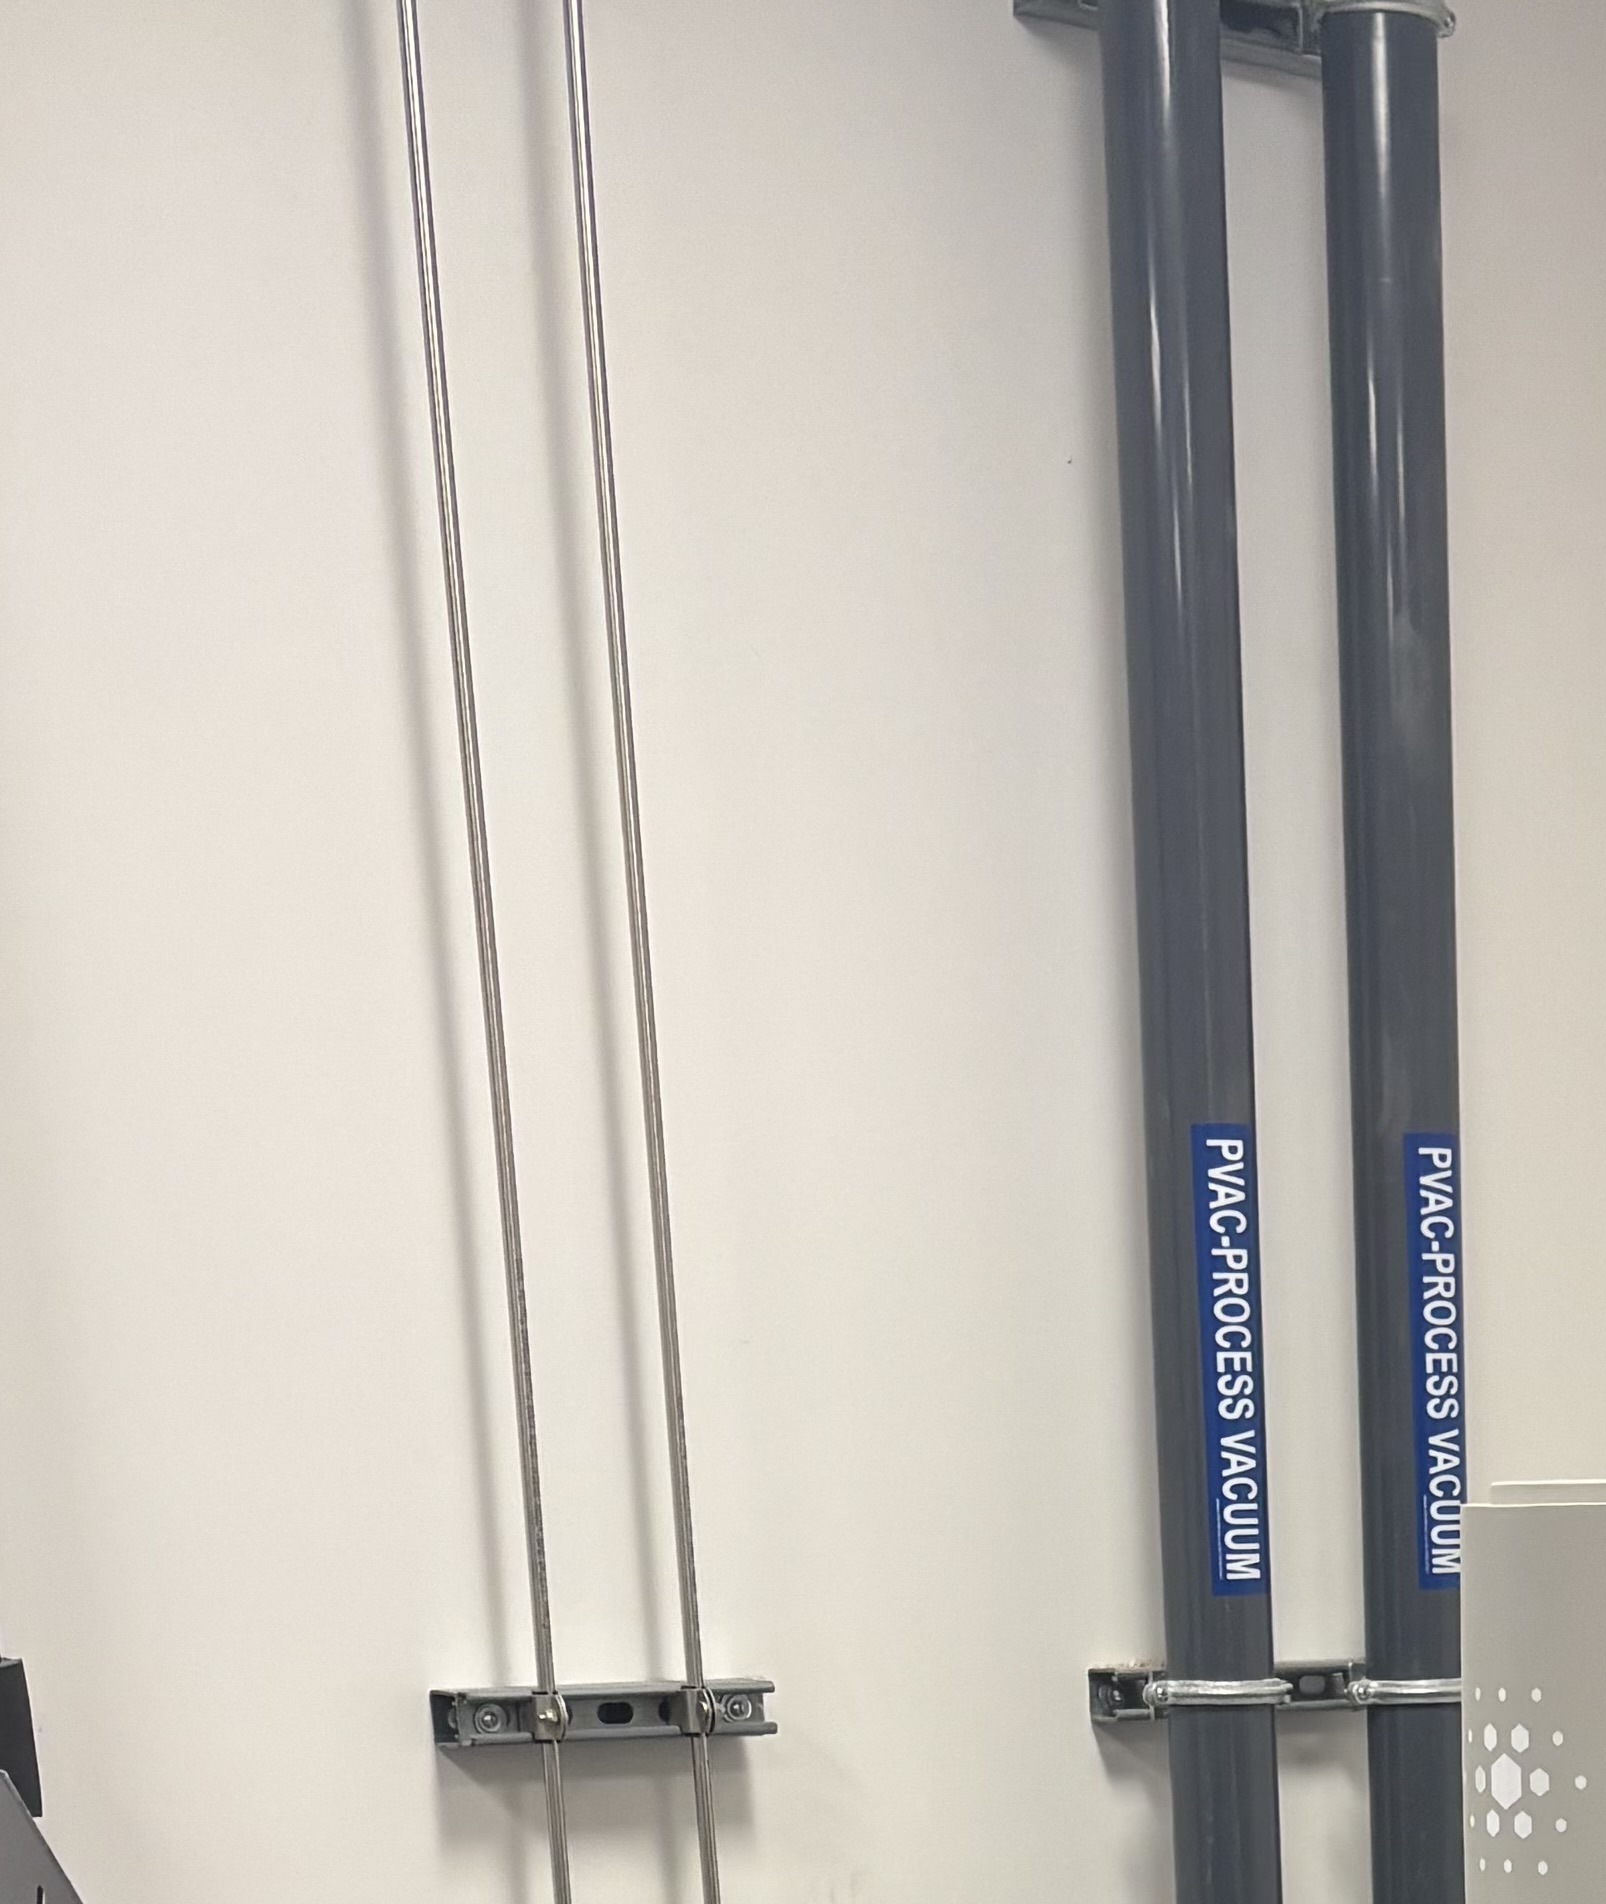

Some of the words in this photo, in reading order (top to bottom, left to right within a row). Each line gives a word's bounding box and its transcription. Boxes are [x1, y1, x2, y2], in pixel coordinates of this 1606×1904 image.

[1206, 1138, 1254, 1420] PVAC-PROCESS
[1418, 1146, 1459, 1420] PVAC-PROCESS
[1220, 1429, 1261, 1581] VACUUM
[1428, 1428, 1461, 1575] VACUUM
